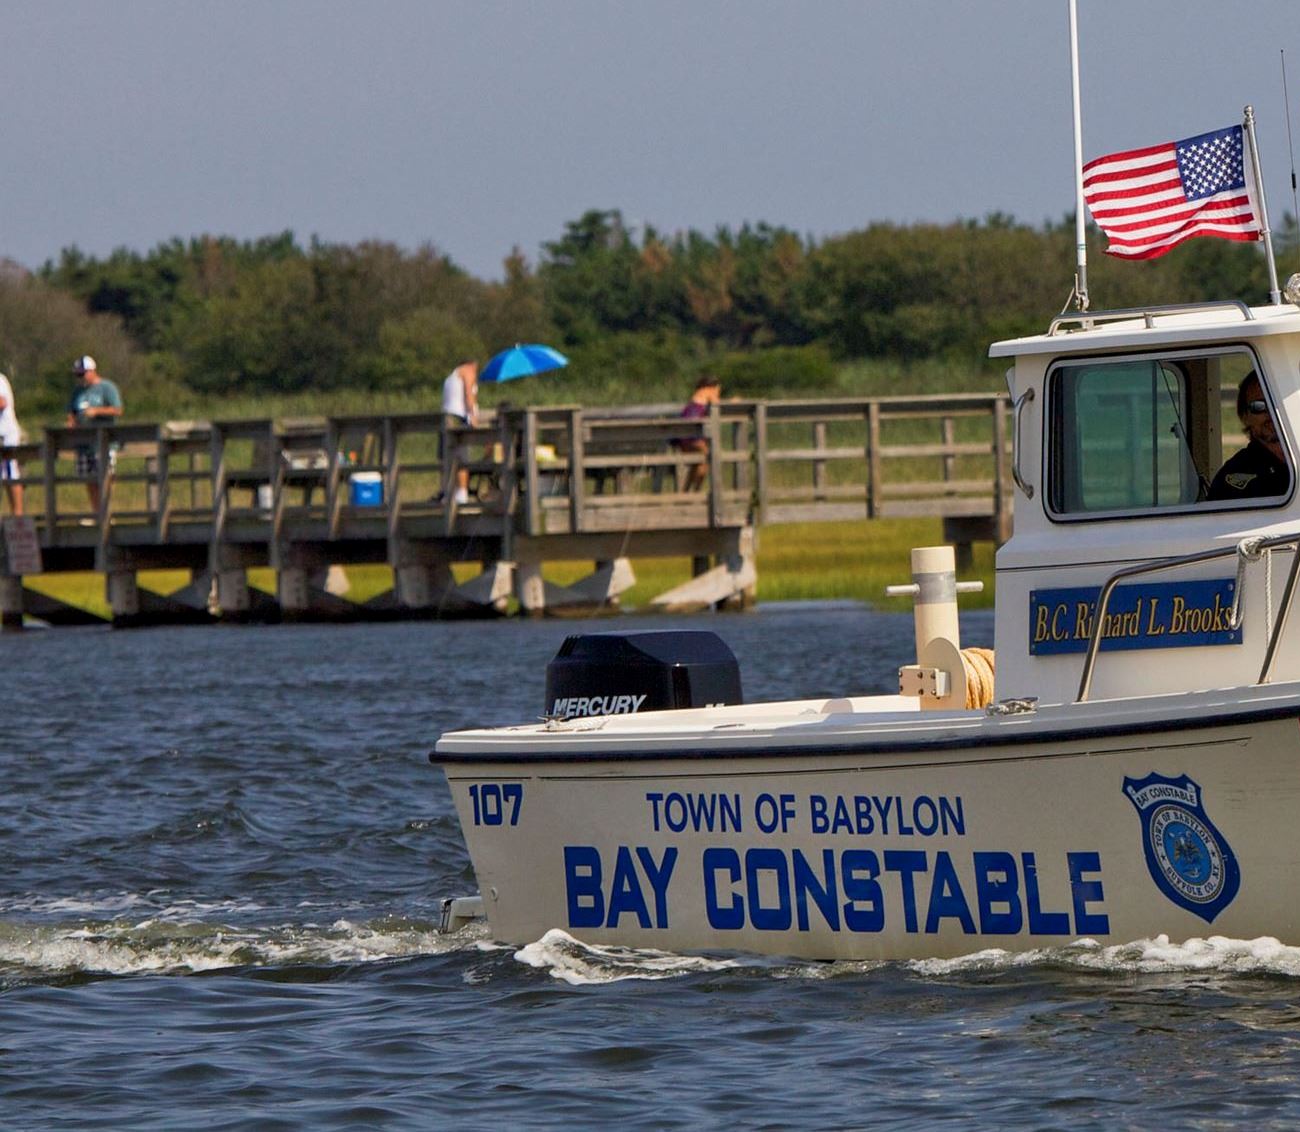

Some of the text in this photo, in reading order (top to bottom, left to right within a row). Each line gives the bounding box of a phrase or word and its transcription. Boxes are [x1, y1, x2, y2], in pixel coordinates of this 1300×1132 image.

[1034, 594, 1231, 642] B.C. Rihard L. Brooks
[553, 695, 647, 717] MERCURY
[469, 784, 523, 826] 107
[646, 792, 965, 836] TOWN OF BABYLON
[1136, 786, 1196, 807] BAY CONSTABLE
[564, 846, 1110, 935] BAY CONSTABLE
